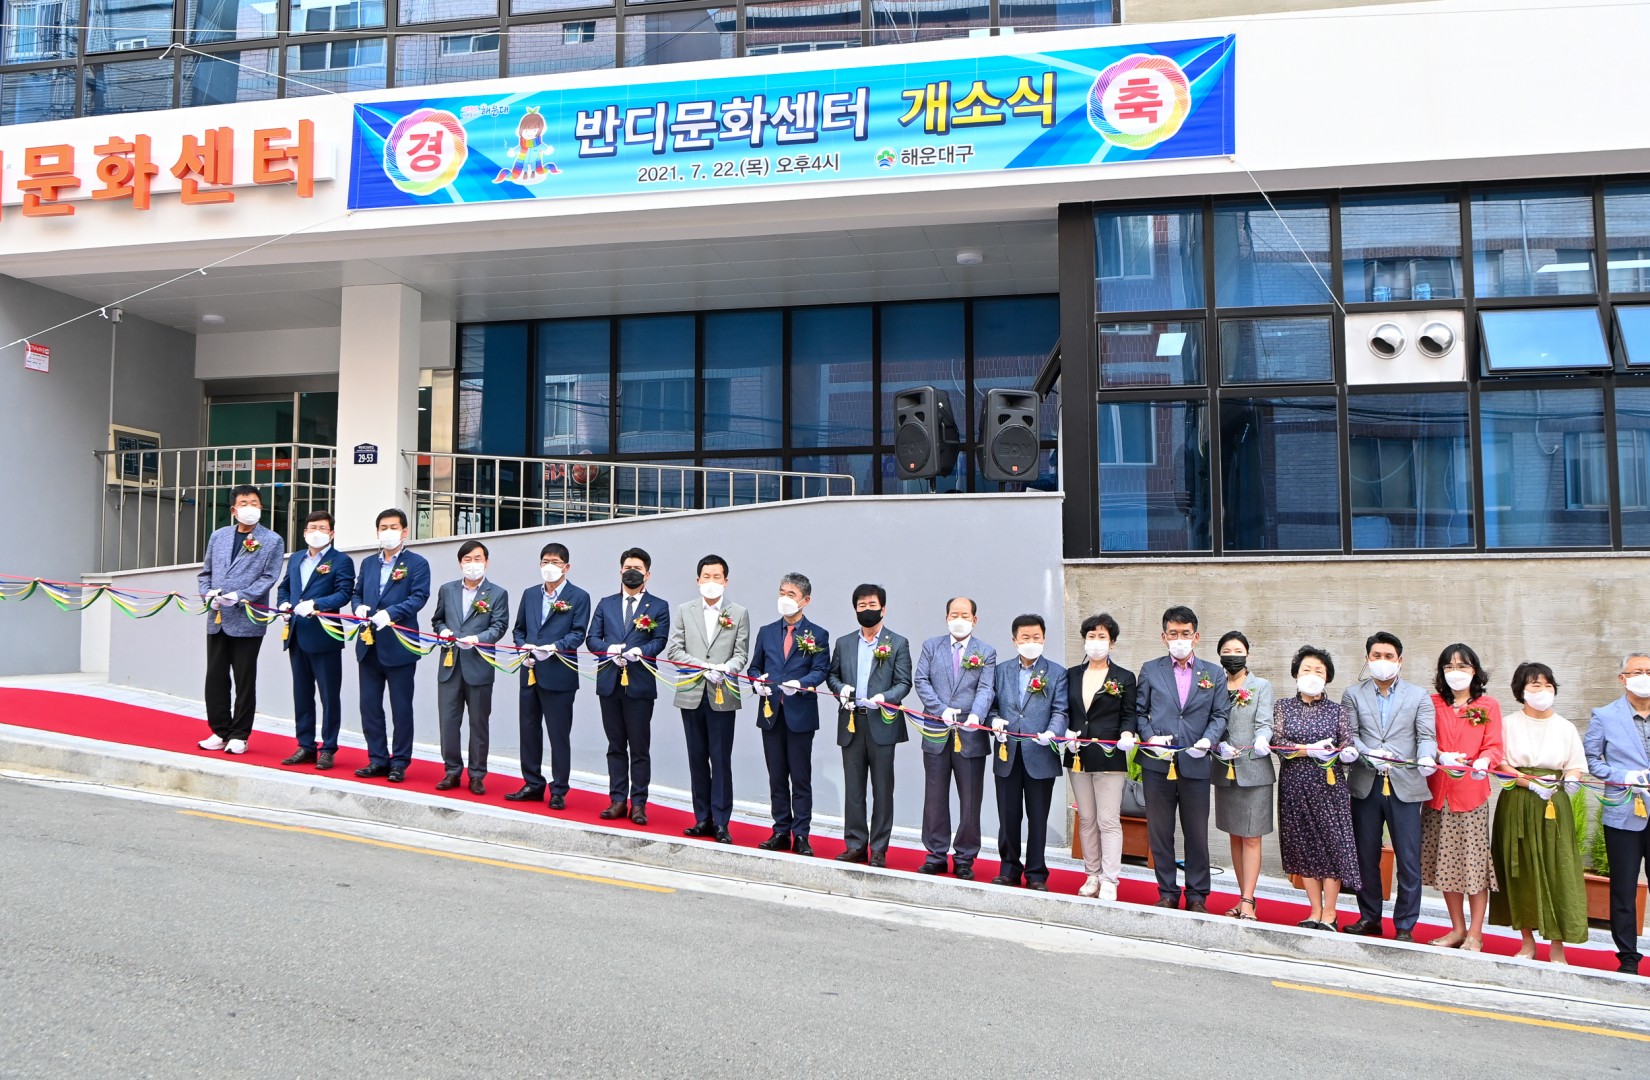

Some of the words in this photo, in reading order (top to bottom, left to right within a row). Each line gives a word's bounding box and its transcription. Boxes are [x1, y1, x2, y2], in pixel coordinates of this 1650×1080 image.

[574, 86, 870, 158] 반디문화센터
[898, 71, 1057, 135] 개소식
[1113, 77, 1163, 123] 축
[0, 118, 314, 222] 문화센터
[406, 130, 444, 173] 경
[637, 167, 684, 183] 2021.
[690, 164, 706, 179] 7.
[713, 158, 770, 178] 22.(목)
[776, 153, 839, 174] 오후4시
[901, 145, 974, 165] 해운대구
[358, 453, 374, 463] 29-53
